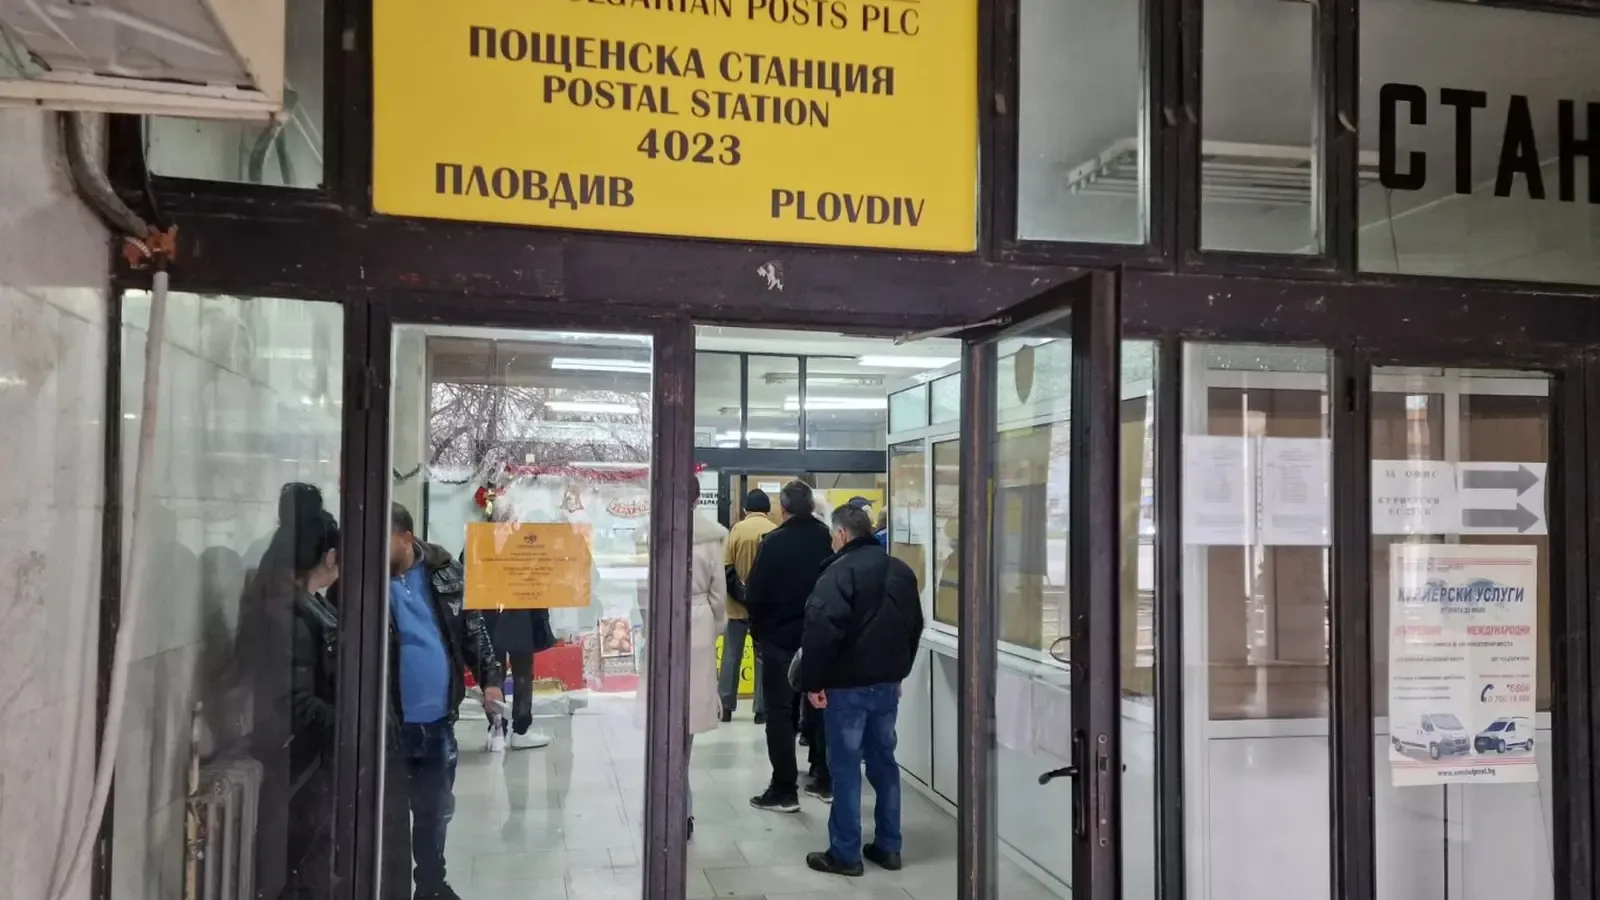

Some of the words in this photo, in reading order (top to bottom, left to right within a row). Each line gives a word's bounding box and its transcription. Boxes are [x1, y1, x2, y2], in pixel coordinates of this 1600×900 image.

[747, 0, 848, 29] POSTS
[862, 4, 920, 36] PLC
[469, 25, 706, 79] ПОЩЕНСКА
[718, 51, 895, 97] СТАНЦИЯ
[543, 75, 679, 115] POSTAL
[690, 90, 830, 128] STATION
[636, 127, 742, 166] 4023
[435, 162, 636, 210] ПЛОВДИВ
[771, 189, 926, 227] PLOVDIV
[1476, 587, 1525, 602] УСЛУГИ
